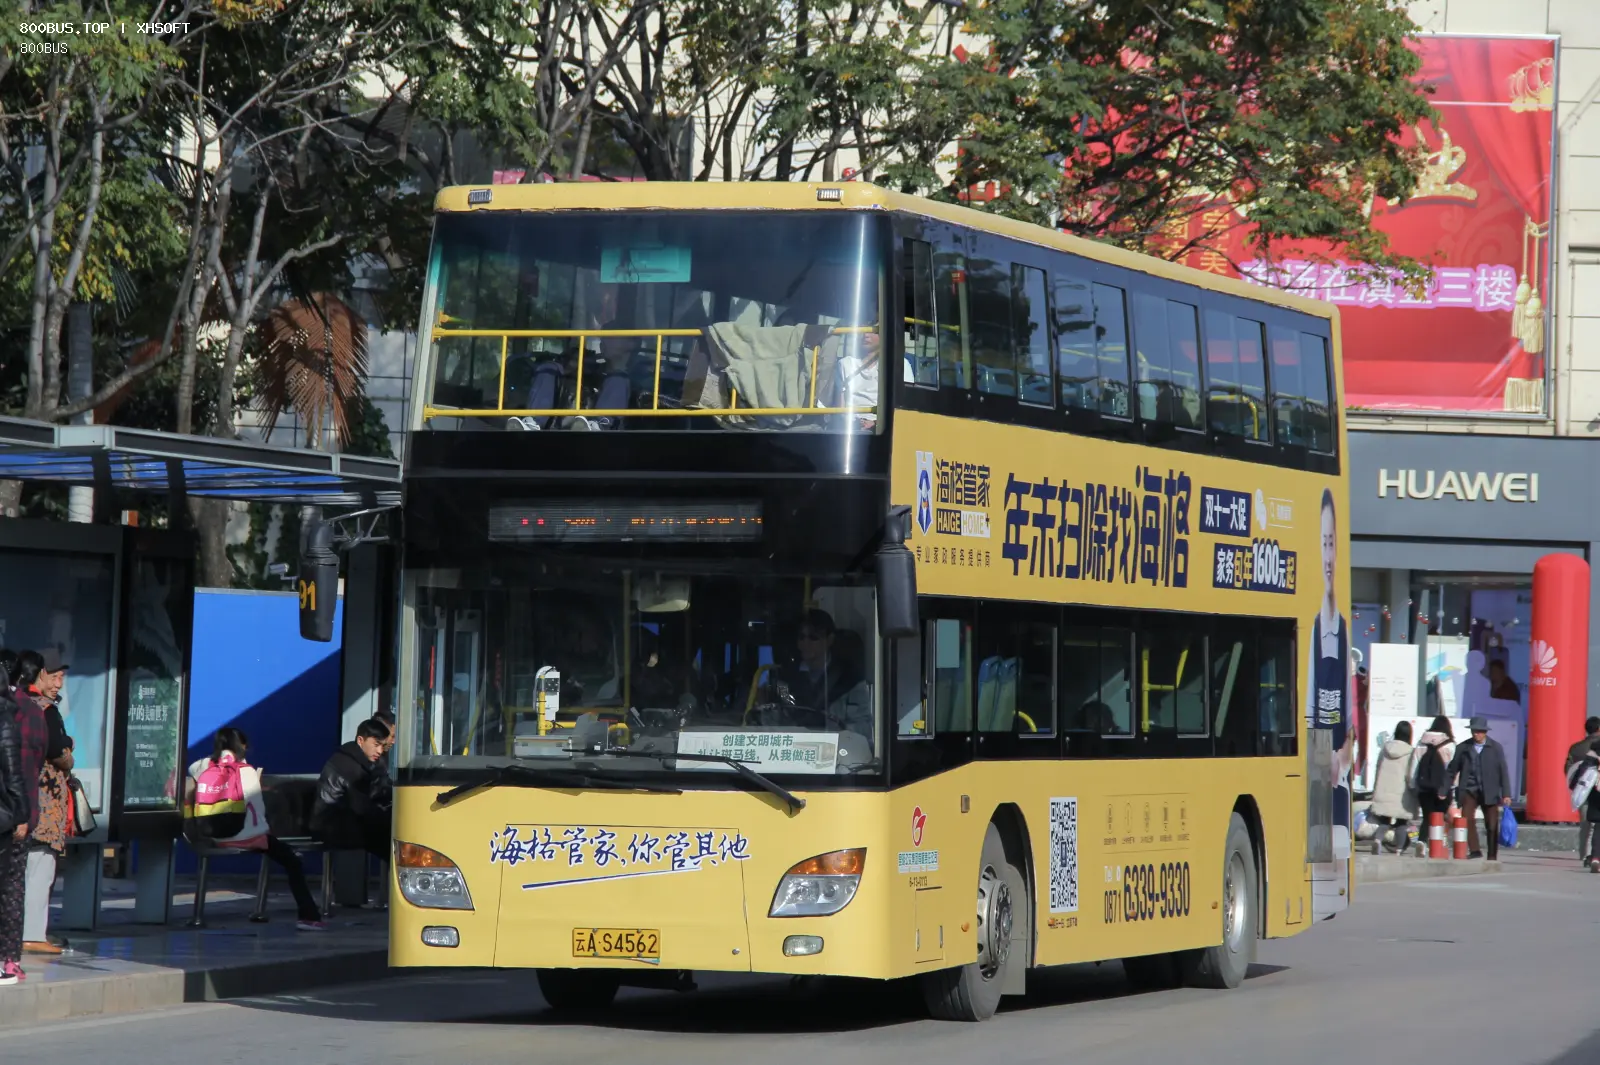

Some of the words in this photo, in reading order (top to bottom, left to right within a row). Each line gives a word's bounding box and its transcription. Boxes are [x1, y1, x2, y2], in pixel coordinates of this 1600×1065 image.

[936, 458, 991, 508] 海格管家
[1378, 468, 1539, 503] HUAWEI
[937, 510, 961, 533] HAIGE
[1002, 465, 1192, 589] 年末扫除找海格
[1205, 493, 1247, 531] 双十一大促
[299, 579, 316, 611] 91
[722, 734, 794, 747] 创建文明城市
[1104, 889, 1122, 924] 0871
[1124, 861, 1190, 922] 6339-9330
